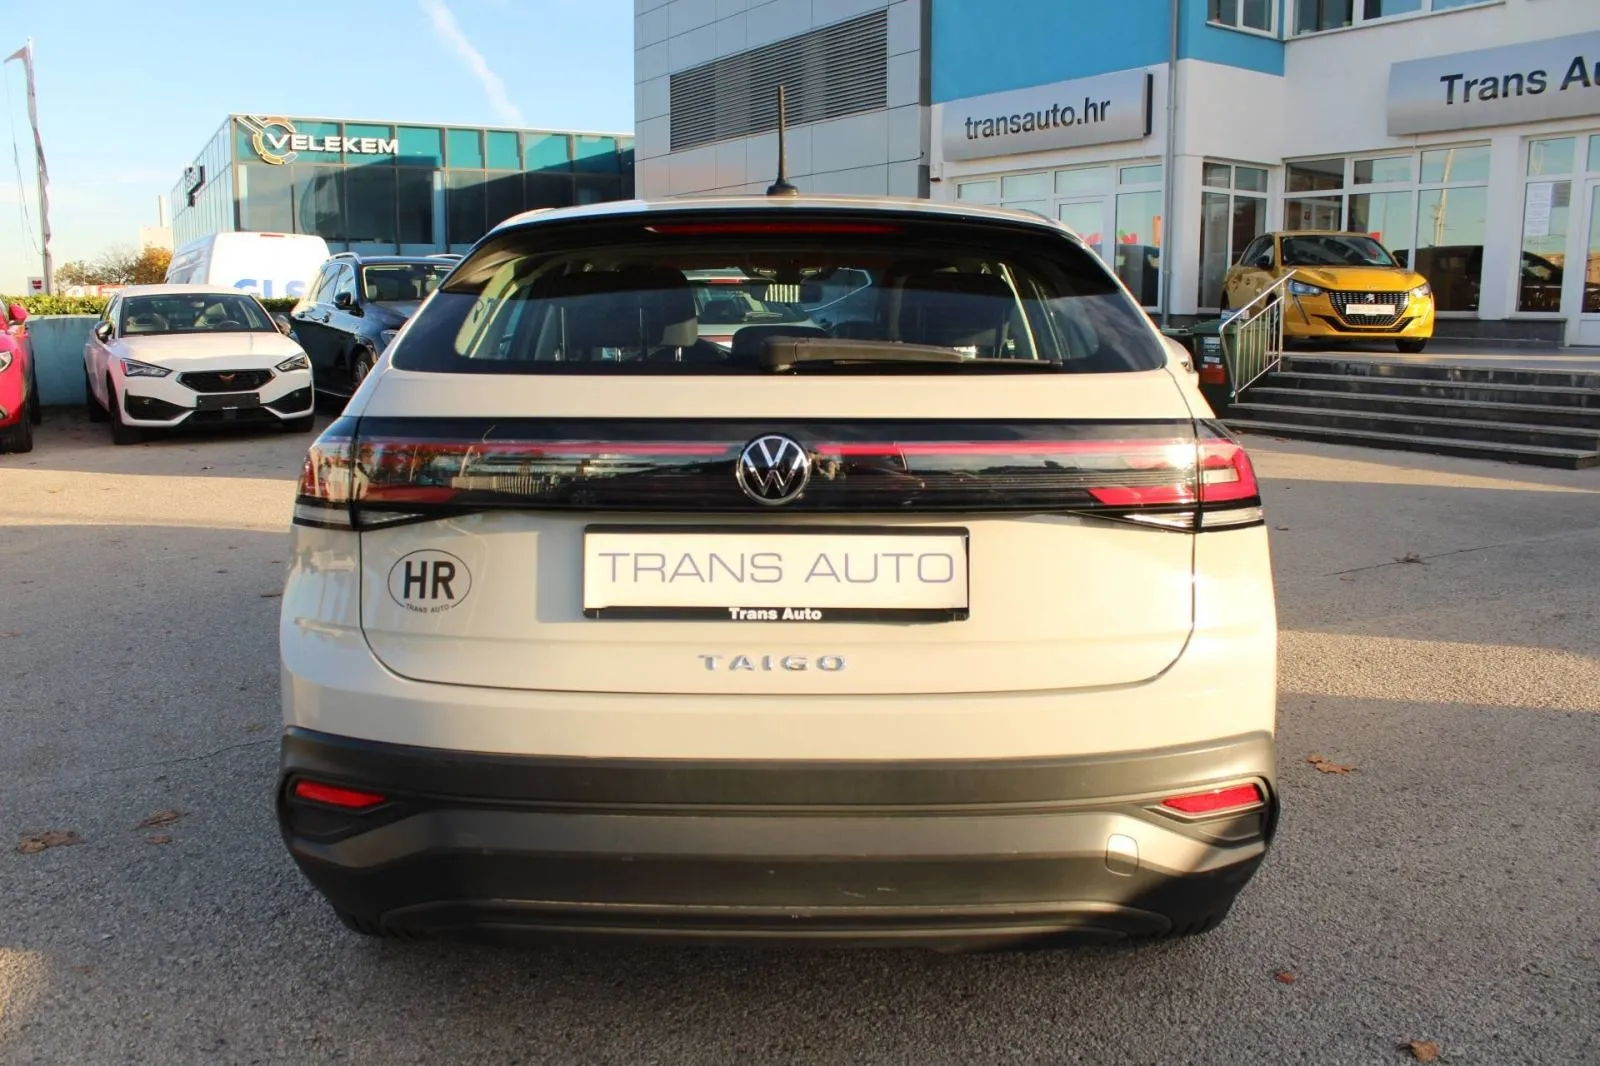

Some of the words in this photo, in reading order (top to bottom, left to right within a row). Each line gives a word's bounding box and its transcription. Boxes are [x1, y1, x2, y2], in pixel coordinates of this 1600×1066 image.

[1440, 69, 1547, 105] Trans
[1559, 56, 1600, 91] A
[965, 97, 1111, 140] transauto.hr
[265, 132, 399, 155] VELEKEM
[404, 561, 456, 599] HR
[598, 552, 783, 583] TRANS
[804, 553, 954, 583] AUTO
[728, 607, 778, 621] Trans
[782, 607, 822, 621] Auto
[697, 654, 847, 672] TAIGO
